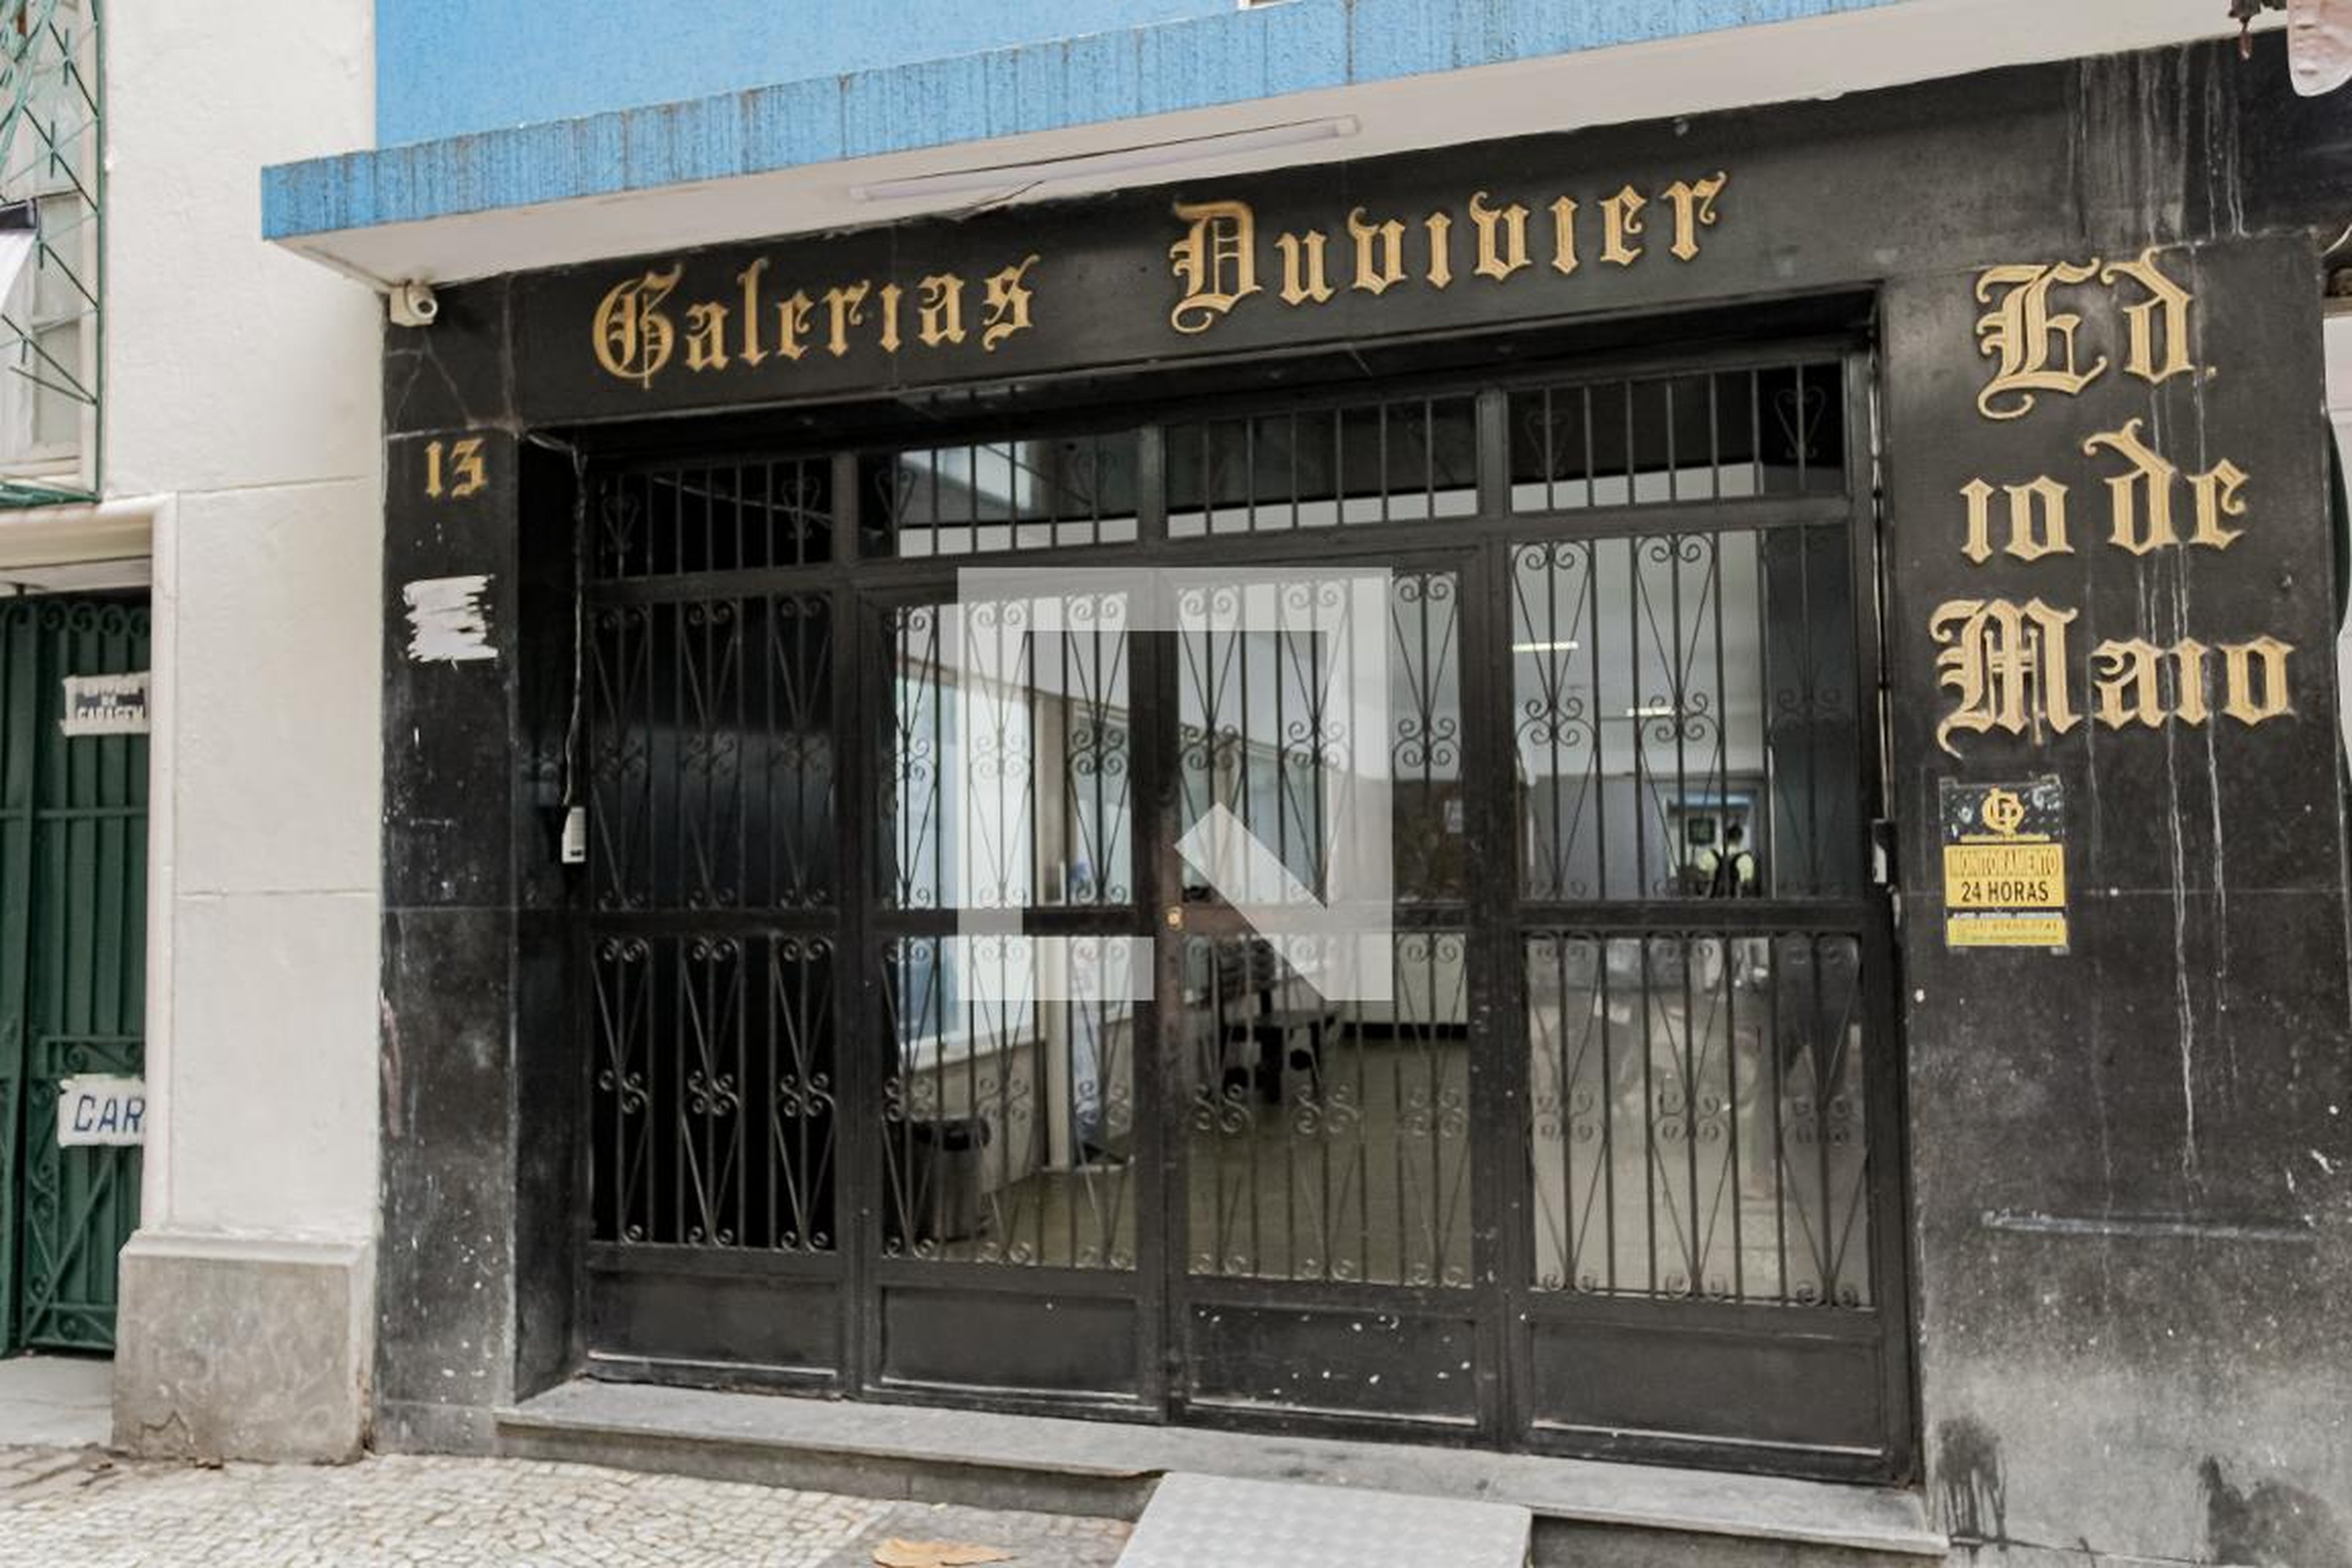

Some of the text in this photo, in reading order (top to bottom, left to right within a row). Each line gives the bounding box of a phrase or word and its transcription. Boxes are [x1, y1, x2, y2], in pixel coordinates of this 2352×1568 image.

[592, 170, 1727, 391] Galerias Duvivier
[424, 437, 489, 499] 13
[2084, 418, 2252, 556] de
[1929, 597, 2296, 760] Maio
[1961, 881, 2049, 902] 24 HORAS
